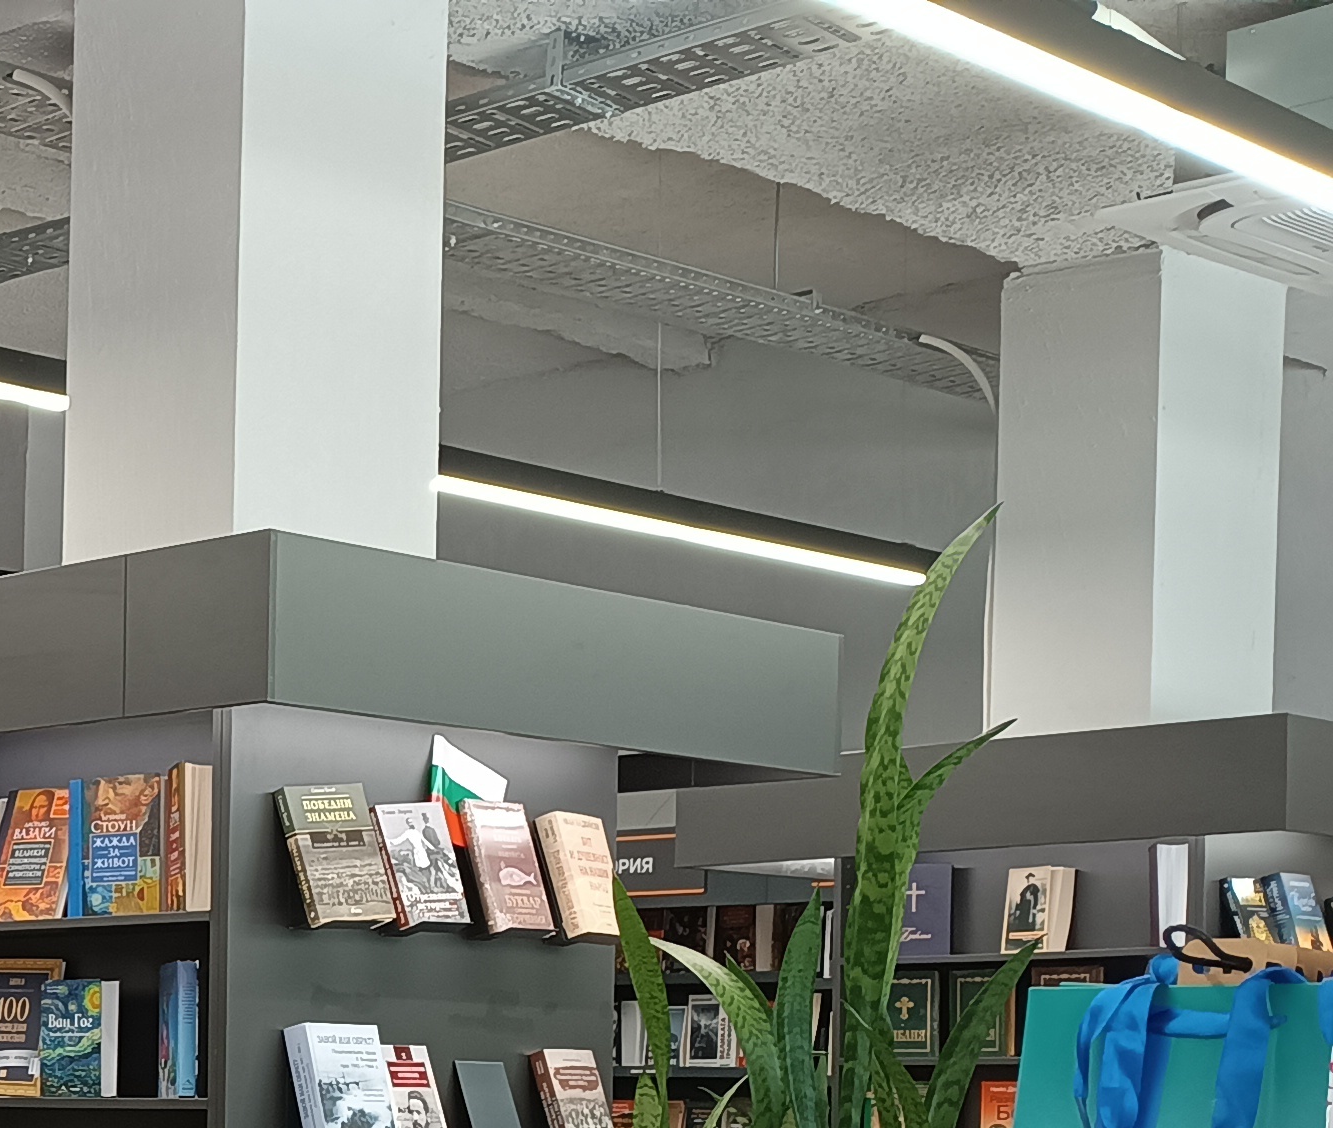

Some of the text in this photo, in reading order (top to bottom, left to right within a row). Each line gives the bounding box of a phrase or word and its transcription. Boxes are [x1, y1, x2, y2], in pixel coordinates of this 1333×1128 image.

[302, 799, 353, 811] ПОБЕДНИ
[304, 810, 357, 823] ЗНАМЕНА
[90, 820, 136, 833] СТОУН
[92, 836, 136, 848] ЖАЖДА
[107, 849, 120, 857] ЗА
[93, 858, 135, 869] ЖИВОТ
[47, 1013, 93, 1029] Ван Гог
